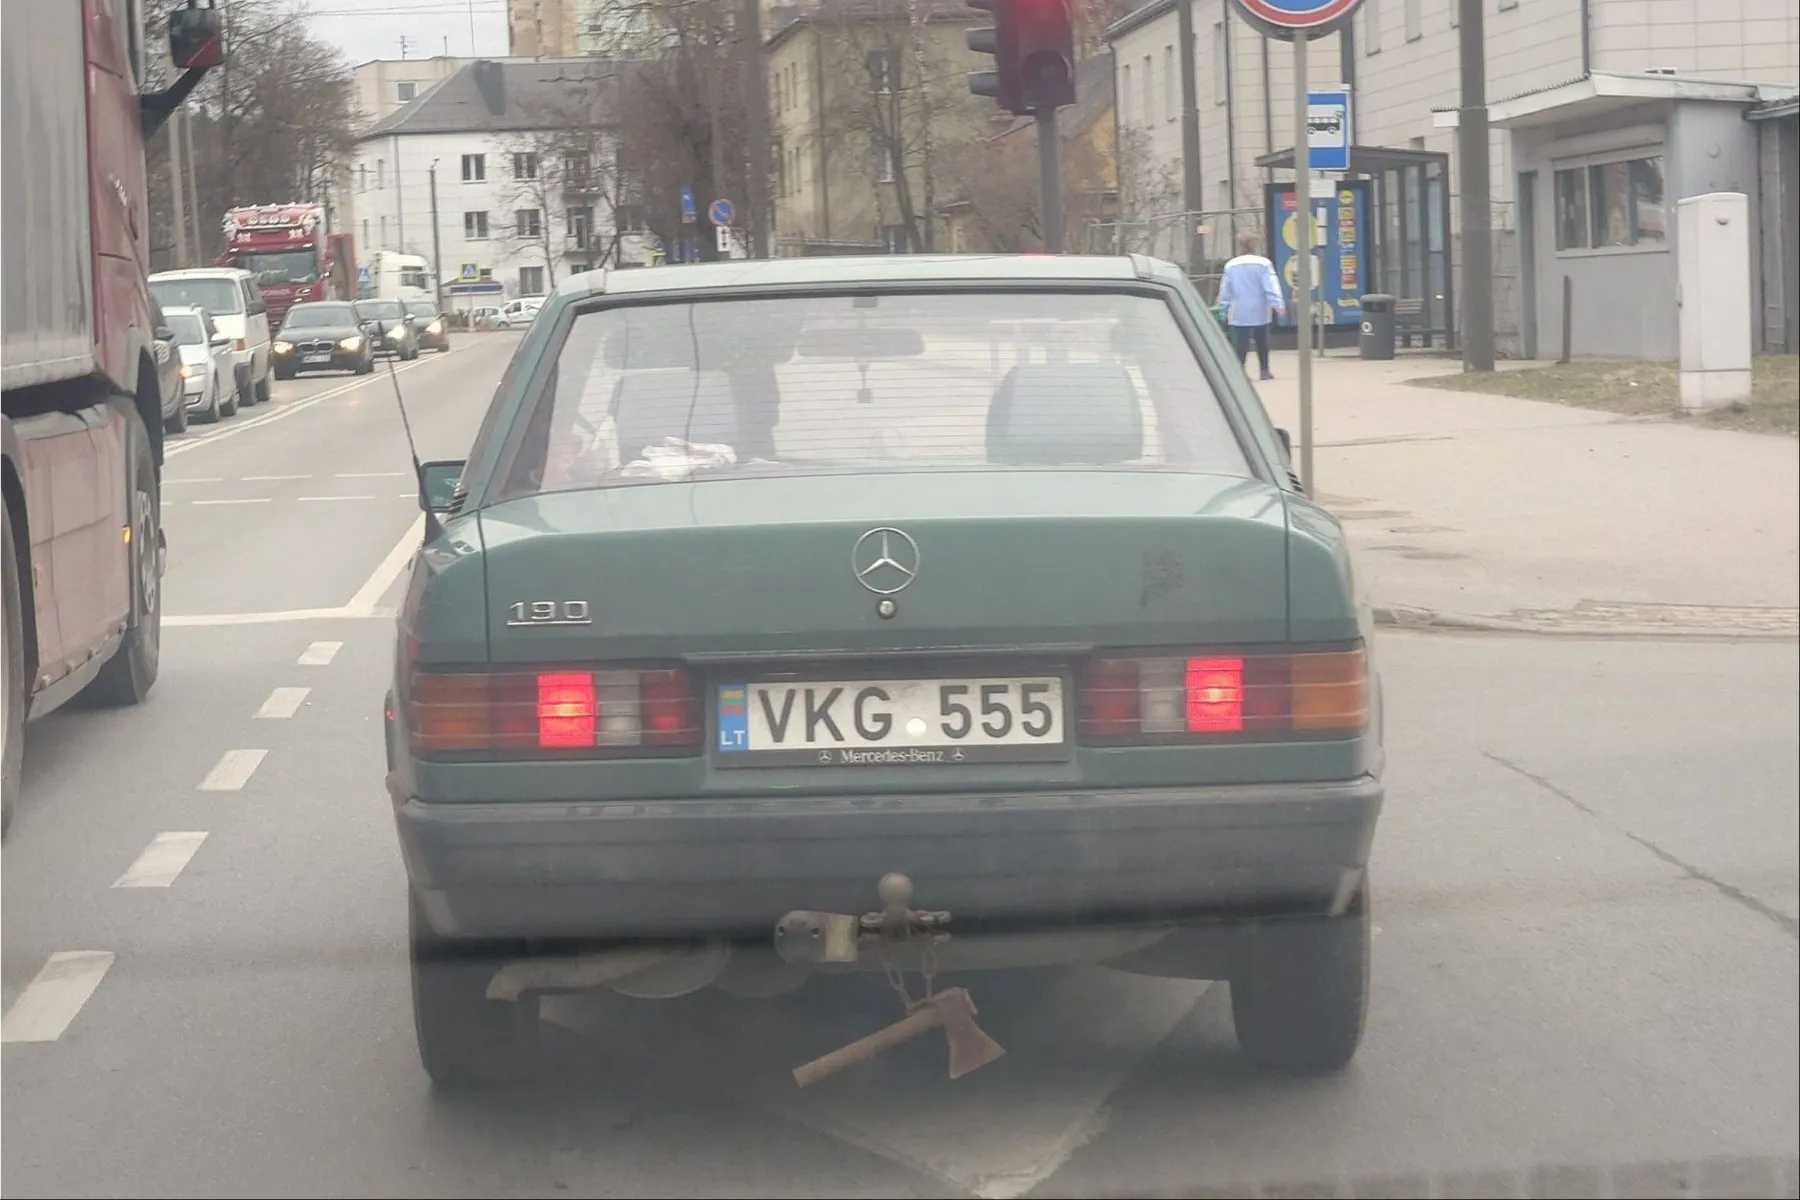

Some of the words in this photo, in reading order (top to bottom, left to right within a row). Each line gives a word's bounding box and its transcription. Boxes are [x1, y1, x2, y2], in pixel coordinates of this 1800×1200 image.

[509, 601, 588, 620] 190
[758, 686, 893, 743] VKG
[939, 683, 1053, 739] 555
[720, 729, 746, 746] LT
[840, 748, 943, 763] Mercedes-Benz
